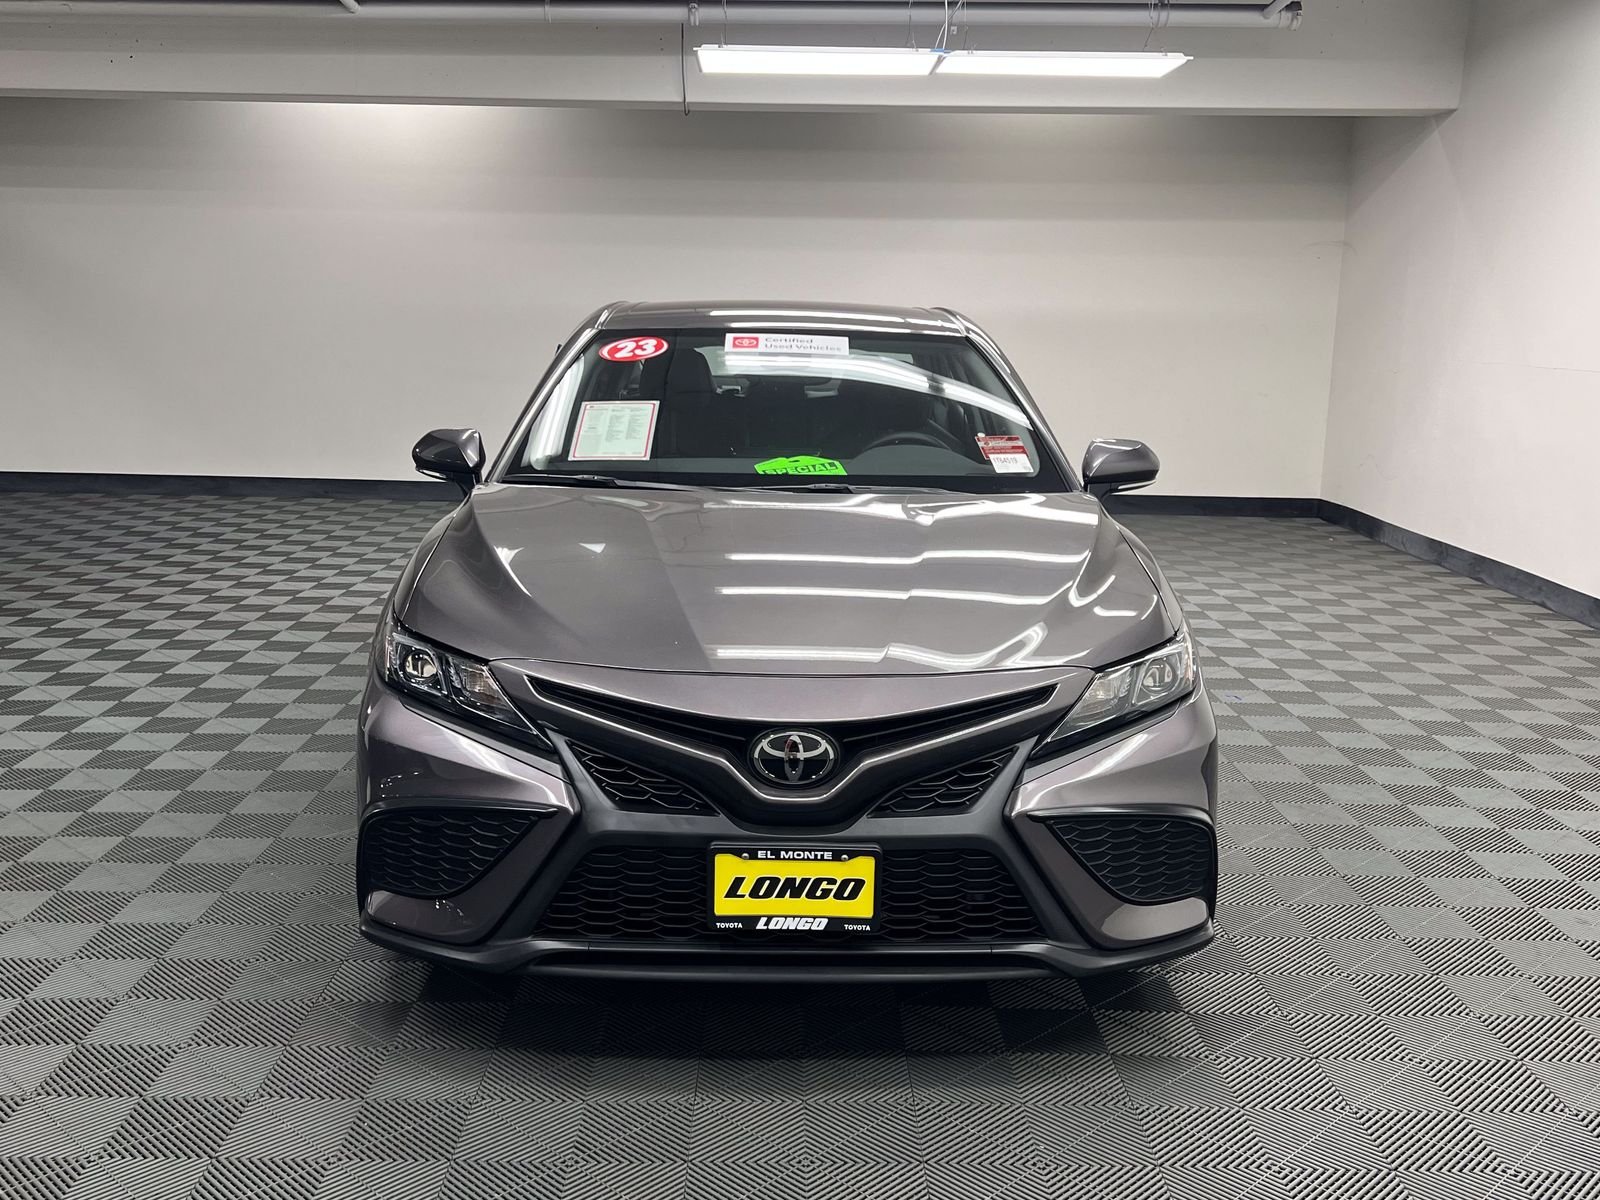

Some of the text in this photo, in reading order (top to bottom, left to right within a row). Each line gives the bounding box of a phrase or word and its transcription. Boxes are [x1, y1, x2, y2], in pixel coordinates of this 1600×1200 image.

[614, 339, 658, 359] 23
[757, 850, 833, 860] EL MONTE
[723, 876, 867, 901] LONGO
[755, 916, 829, 931] LONGO
